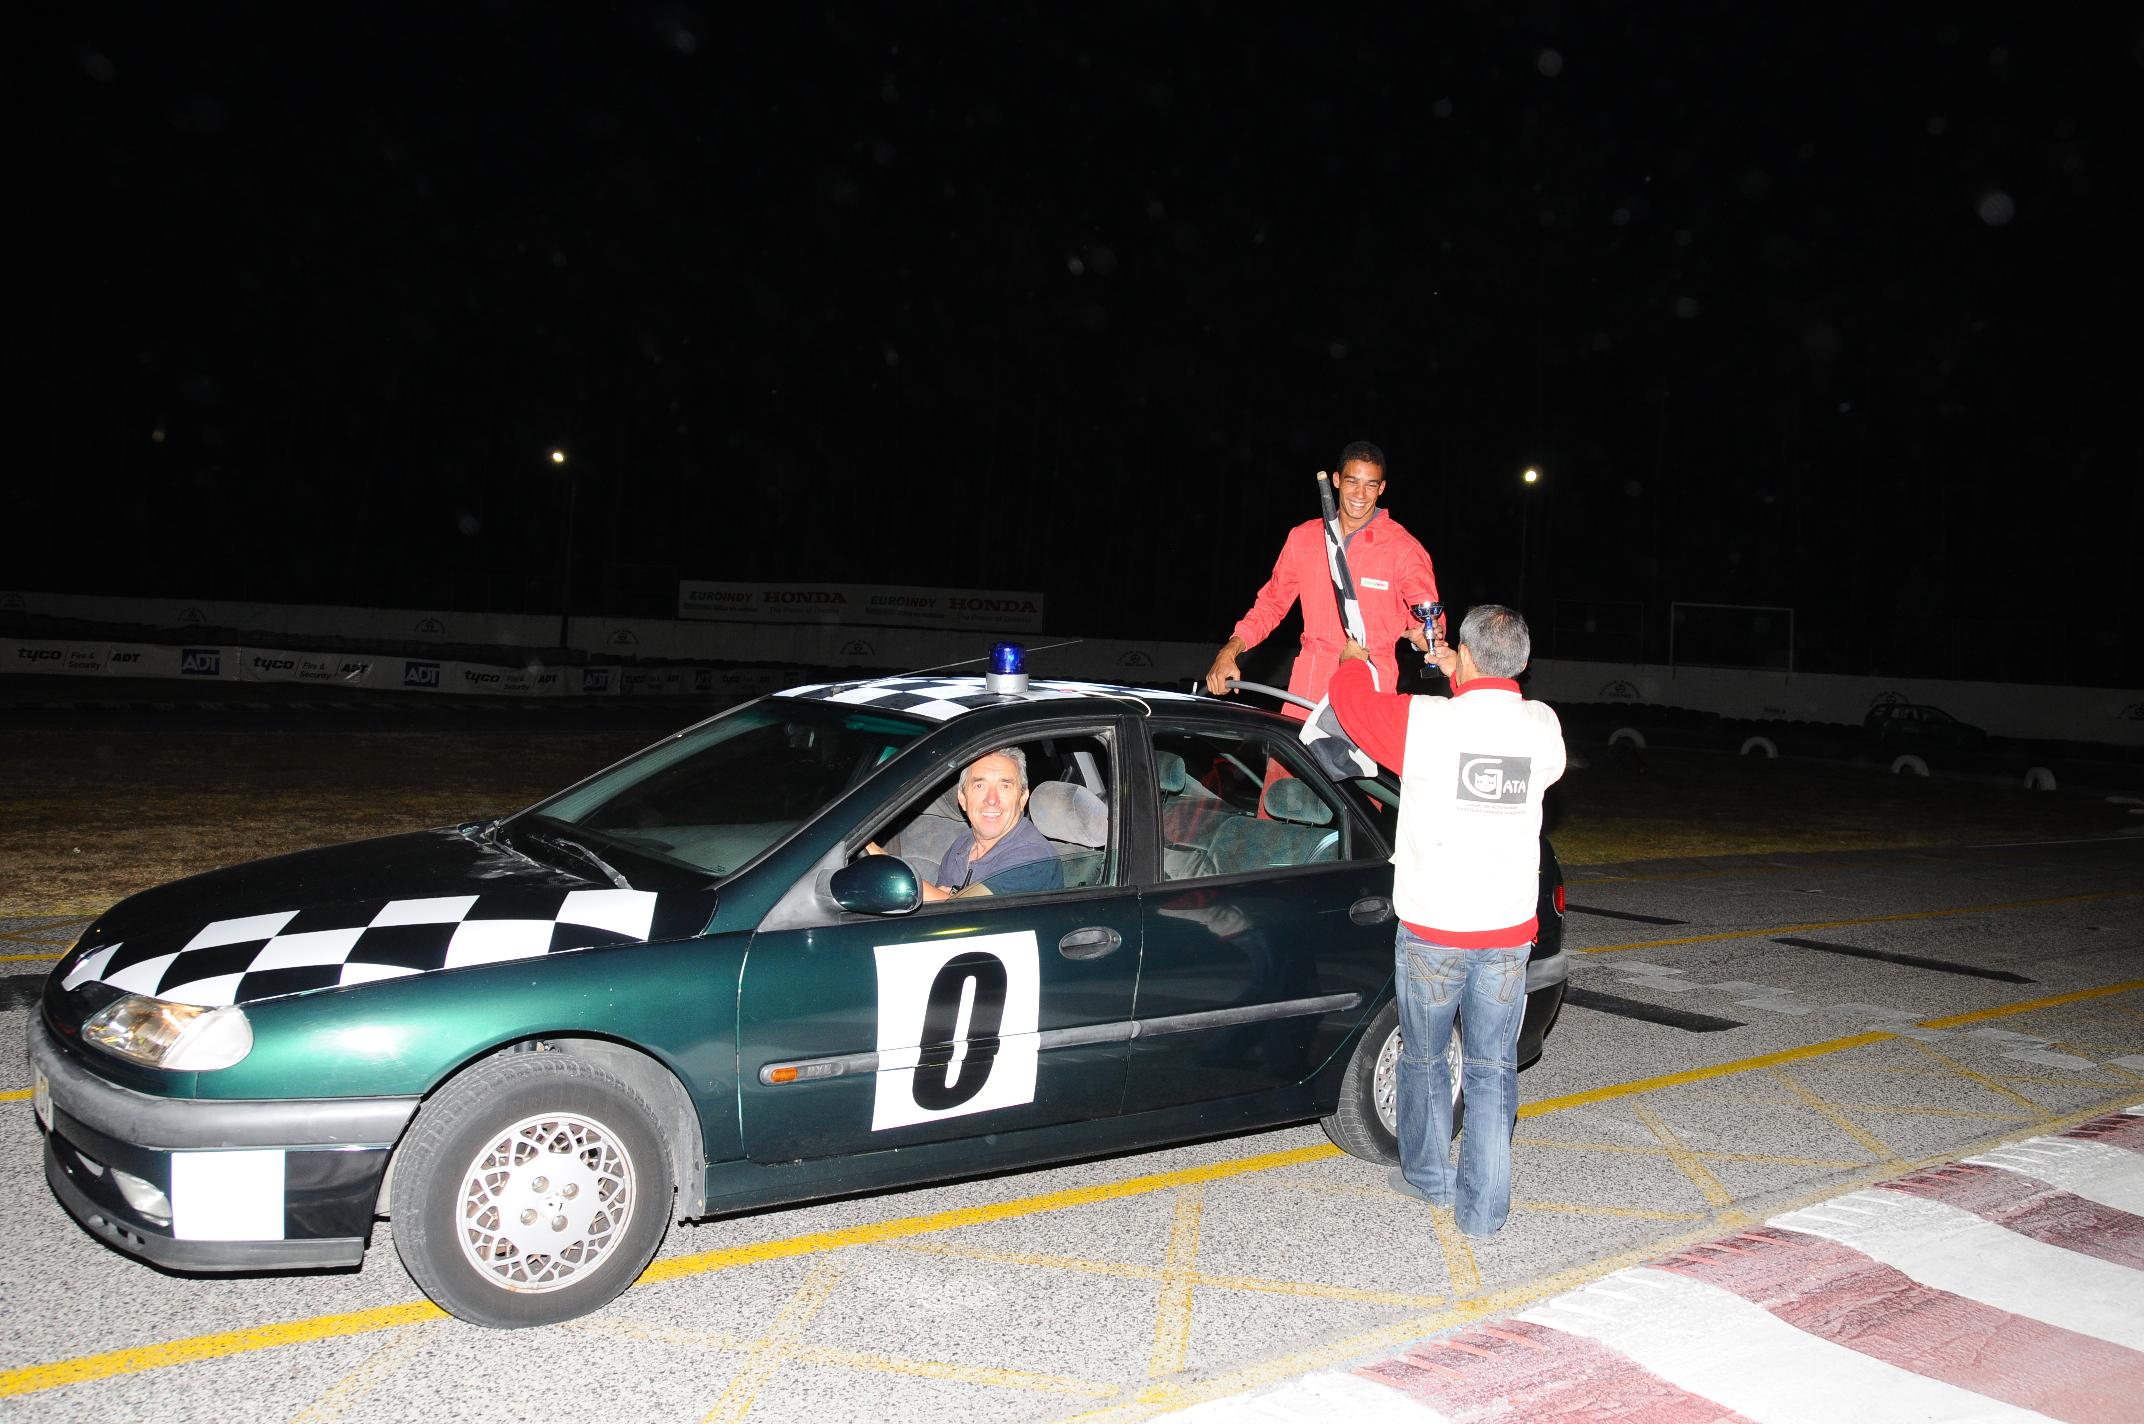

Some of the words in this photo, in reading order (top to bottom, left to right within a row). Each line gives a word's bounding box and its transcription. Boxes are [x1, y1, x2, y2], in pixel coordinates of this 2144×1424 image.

[689, 592, 752, 602] EUROINDY
[764, 592, 848, 604] HONDA
[870, 596, 936, 608] EUROINDY
[949, 598, 1038, 613] HONDA
[17, 648, 62, 661] tyco
[112, 653, 140, 662] ADT
[68, 661, 101, 670] Security
[183, 653, 220, 672] ADT
[253, 656, 294, 671] tyco
[299, 670, 331, 679] Security
[405, 666, 440, 684] ADT
[464, 670, 500, 684] tyco
[538, 674, 558, 684] ADT
[584, 671, 608, 688] ADT
[913, 951, 1008, 1111] 0
